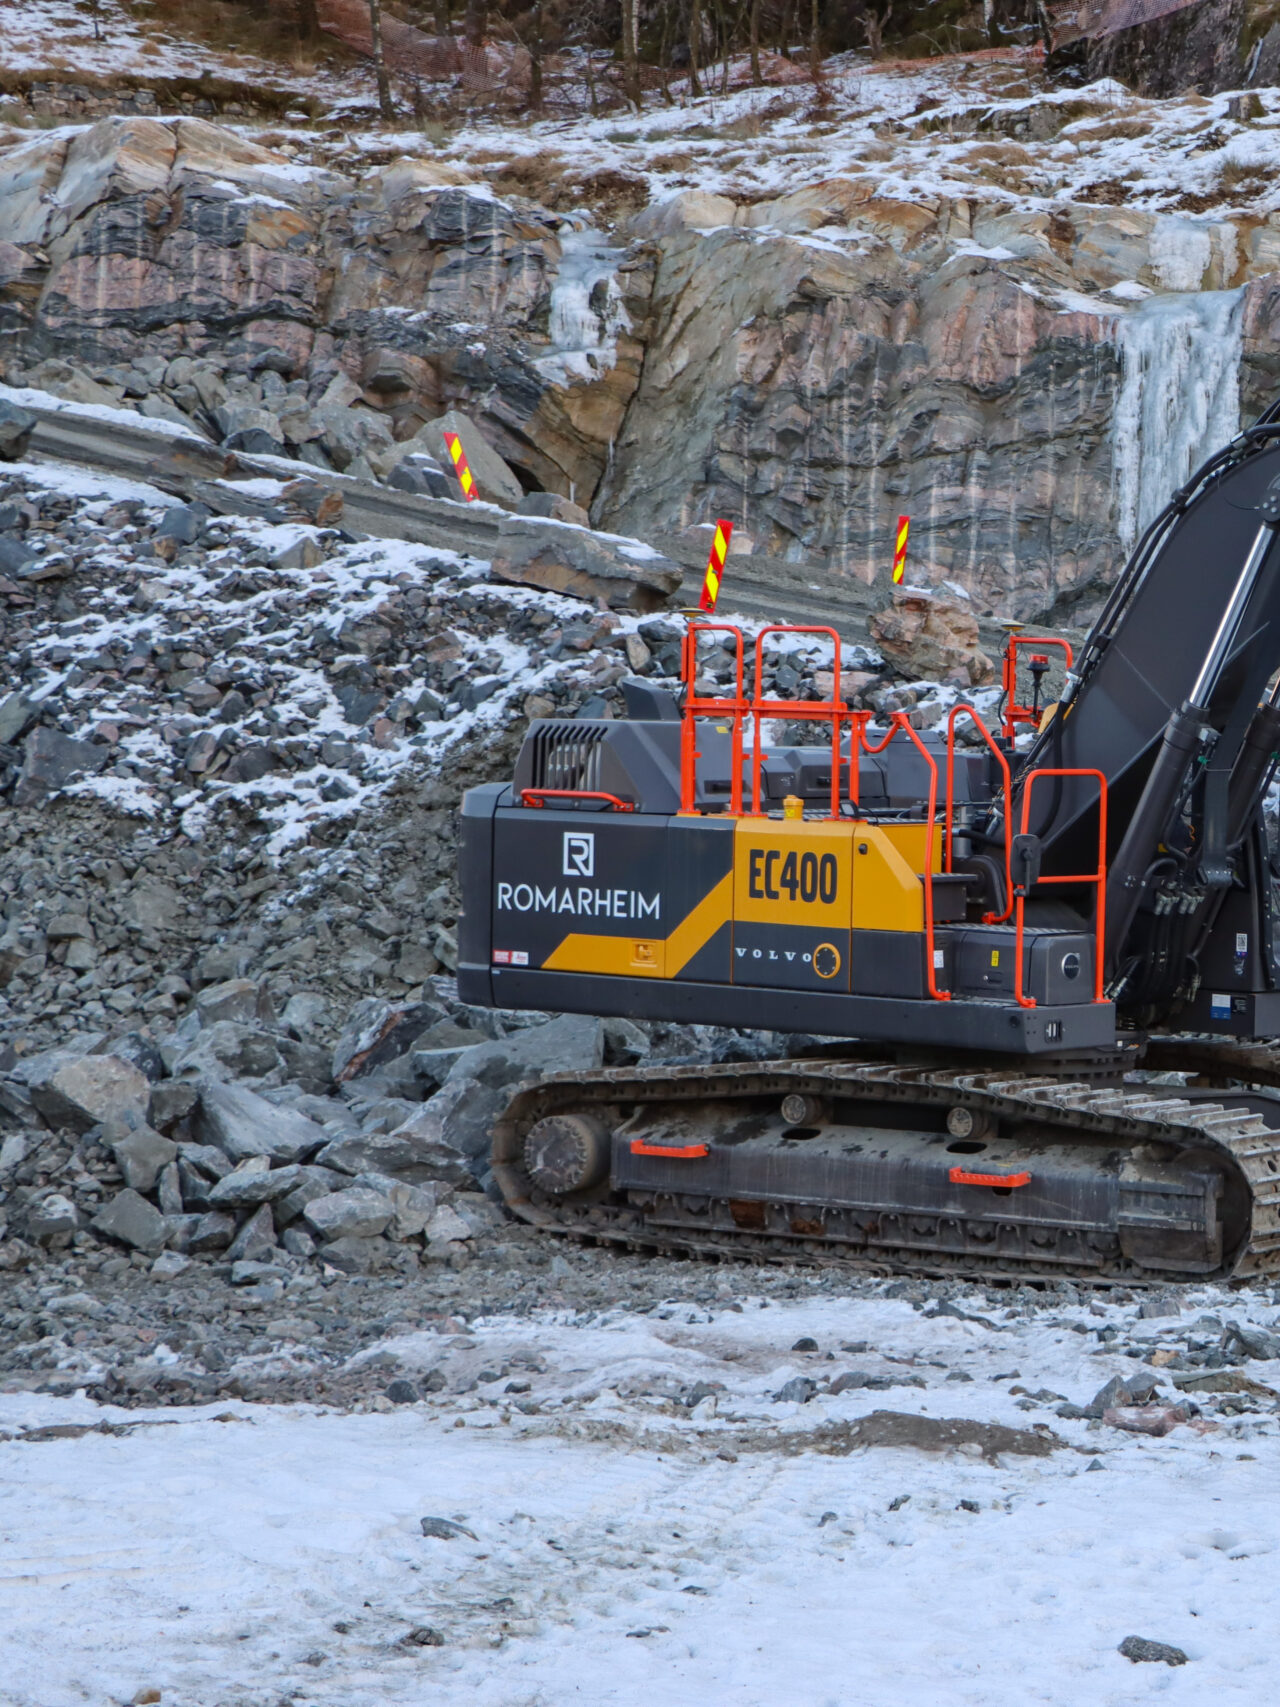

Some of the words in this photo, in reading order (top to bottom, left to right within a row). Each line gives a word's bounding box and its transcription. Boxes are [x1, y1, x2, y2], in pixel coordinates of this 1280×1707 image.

[749, 849, 838, 905] EC400
[498, 882, 661, 920] ROMARHEIM
[735, 947, 812, 962] VOLVO
